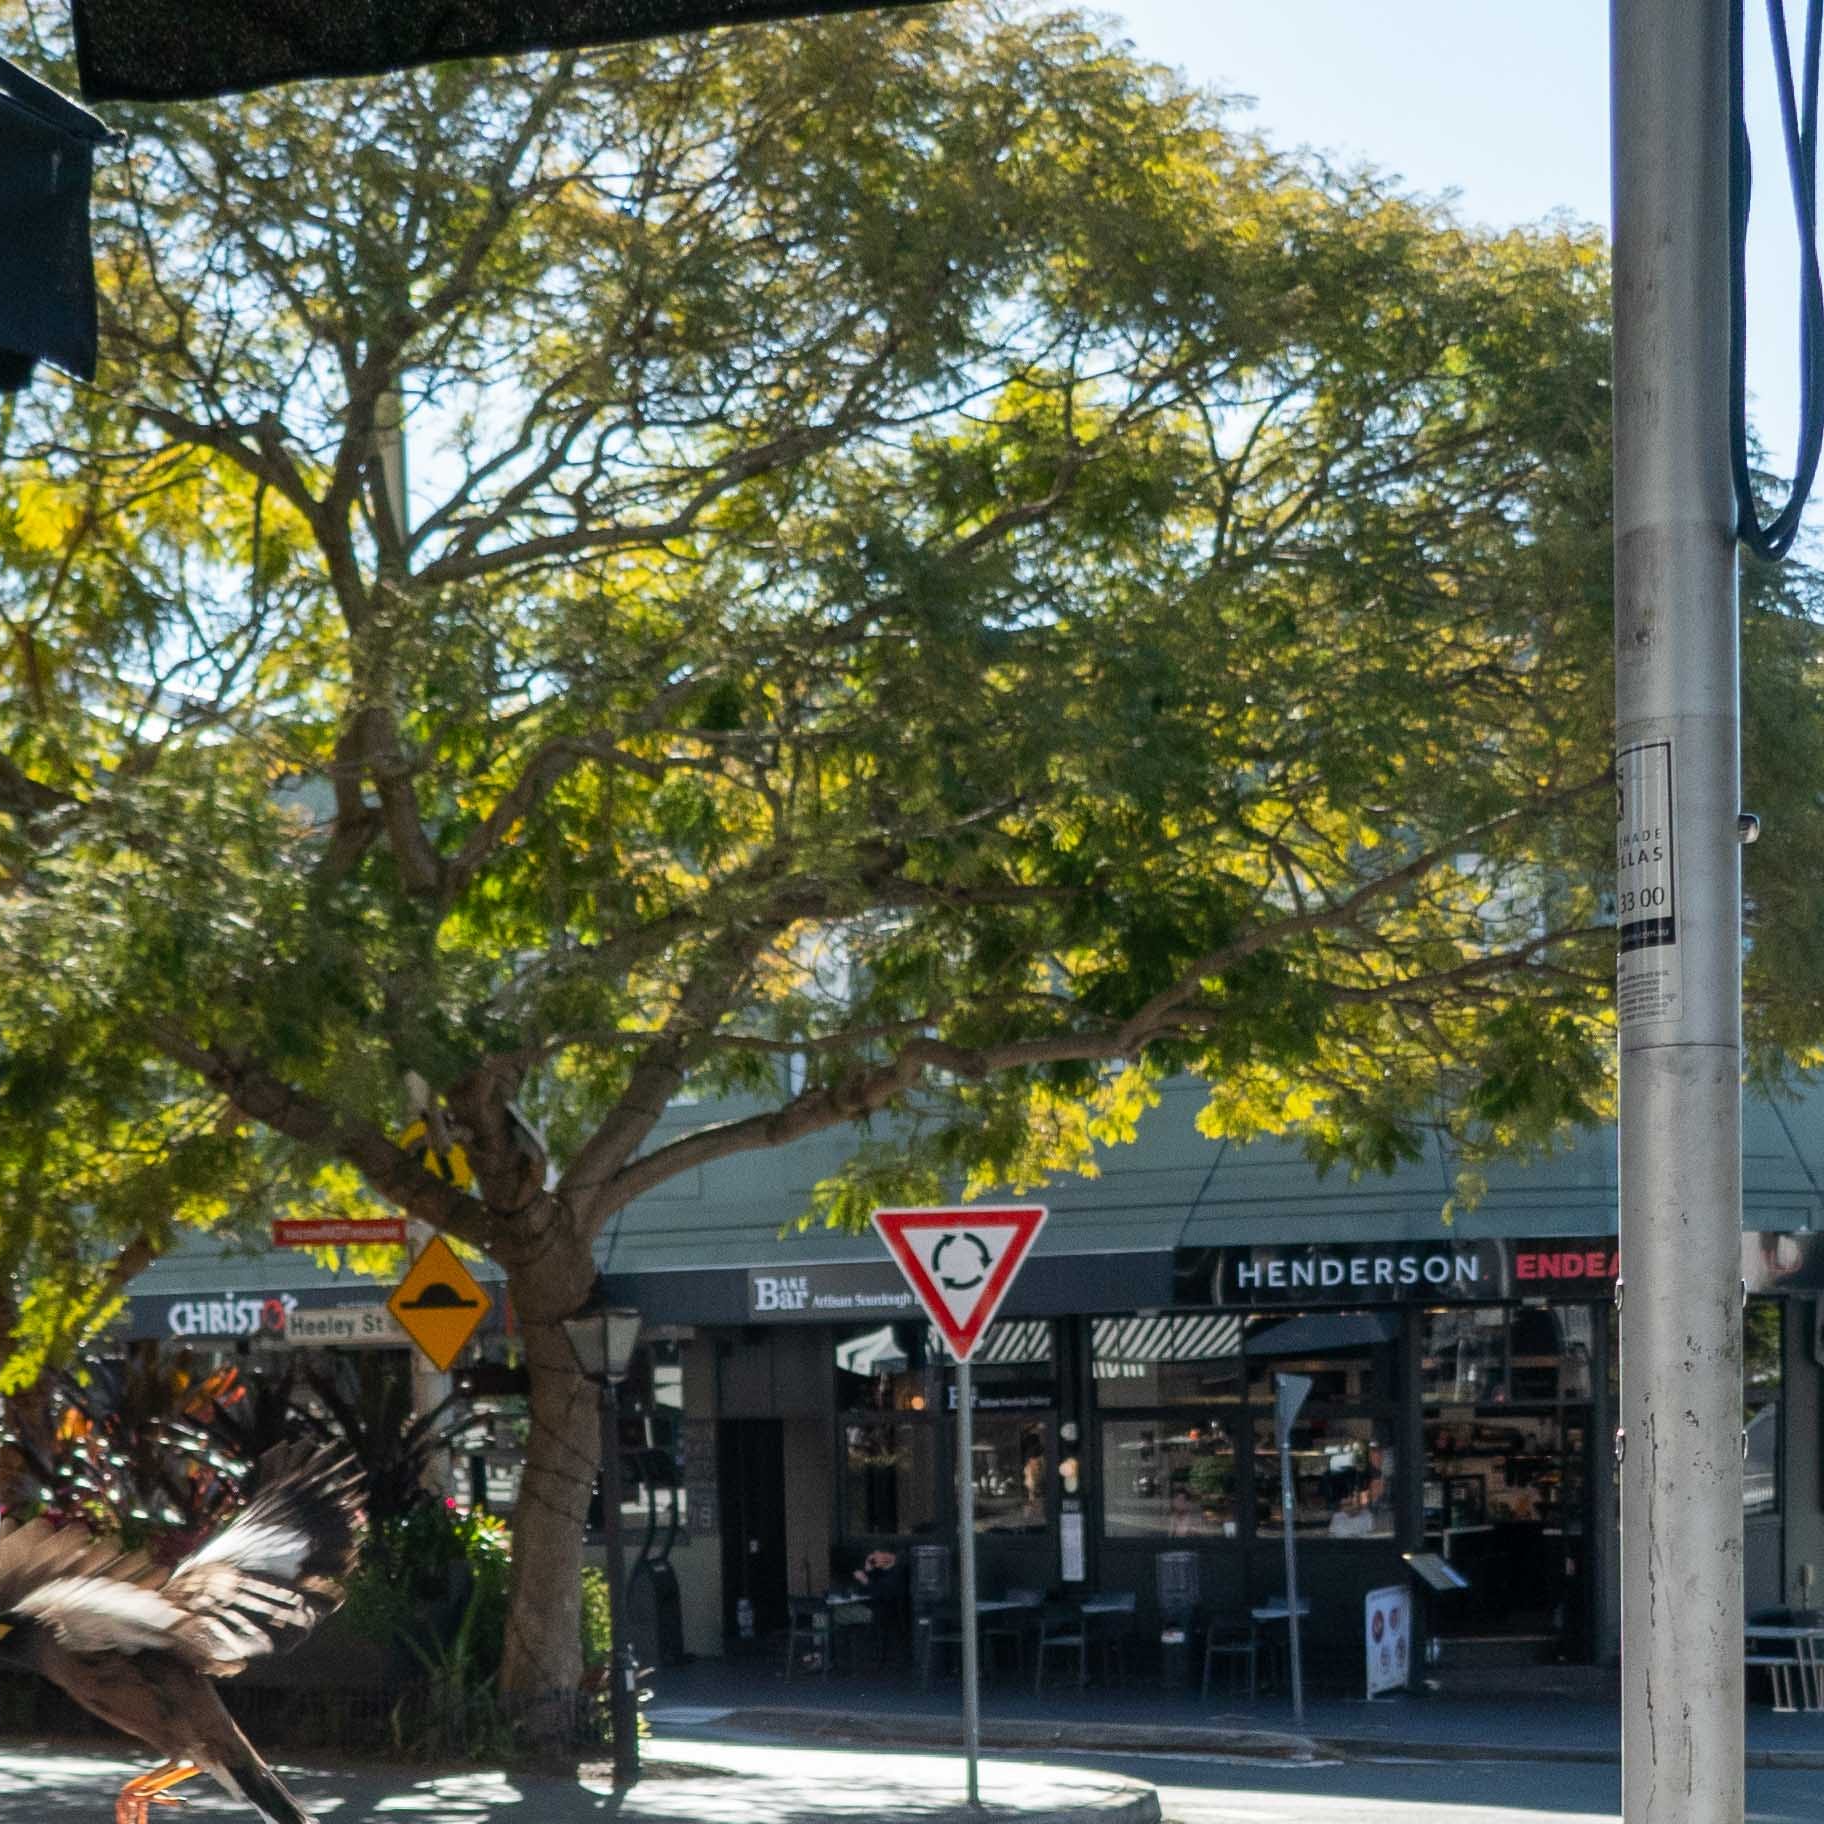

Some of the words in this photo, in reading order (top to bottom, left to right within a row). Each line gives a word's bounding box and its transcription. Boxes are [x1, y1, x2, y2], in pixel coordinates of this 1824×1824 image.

[1640, 886, 1665, 908] 00
[290, 1315, 355, 1337] Heeley
[362, 1313, 383, 1334] St
